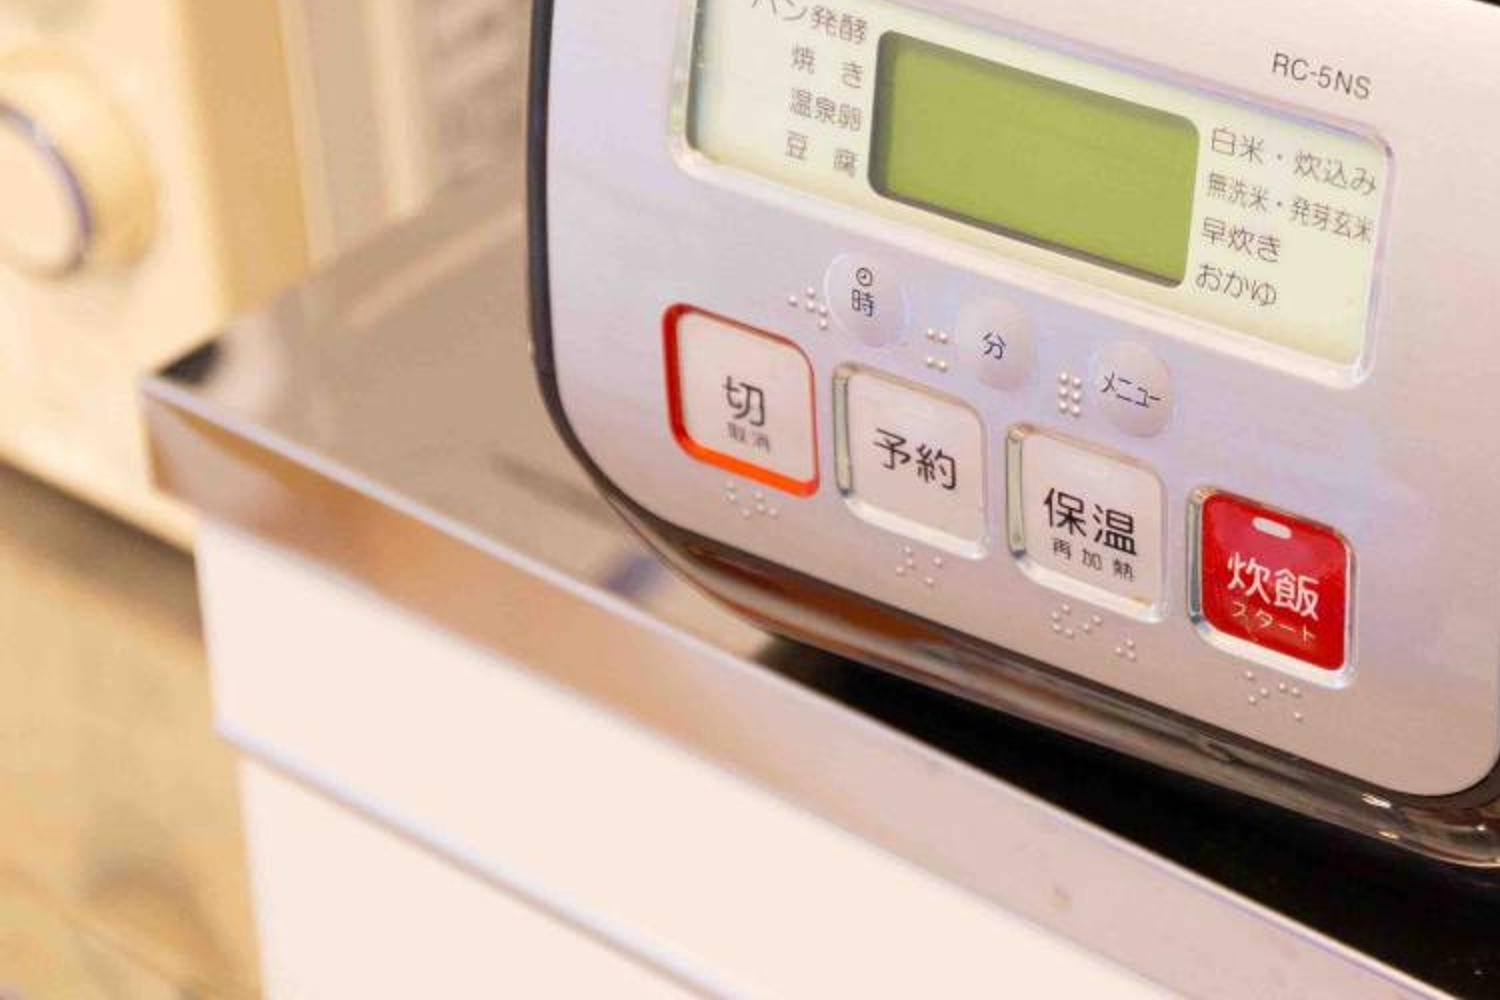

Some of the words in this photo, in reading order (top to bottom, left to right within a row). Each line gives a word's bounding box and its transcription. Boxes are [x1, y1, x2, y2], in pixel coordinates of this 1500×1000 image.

[1271, 52, 1372, 100] RC-5NS
[1210, 127, 1377, 196] 白米・炊込み
[1206, 171, 1374, 244] 無洗米・発芽玄米
[1201, 216, 1281, 263] 早炊き
[851, 288, 876, 318] 時
[1195, 263, 1277, 307] おかゆ
[982, 330, 1006, 360] 分
[721, 375, 766, 428] 切
[1101, 371, 1162, 409] メニュー
[873, 427, 957, 491] 予約
[1043, 487, 1137, 556] 保温
[1052, 537, 1136, 583] 再加熱
[1226, 551, 1320, 622] 炊飯
[1231, 600, 1317, 643] スタート
